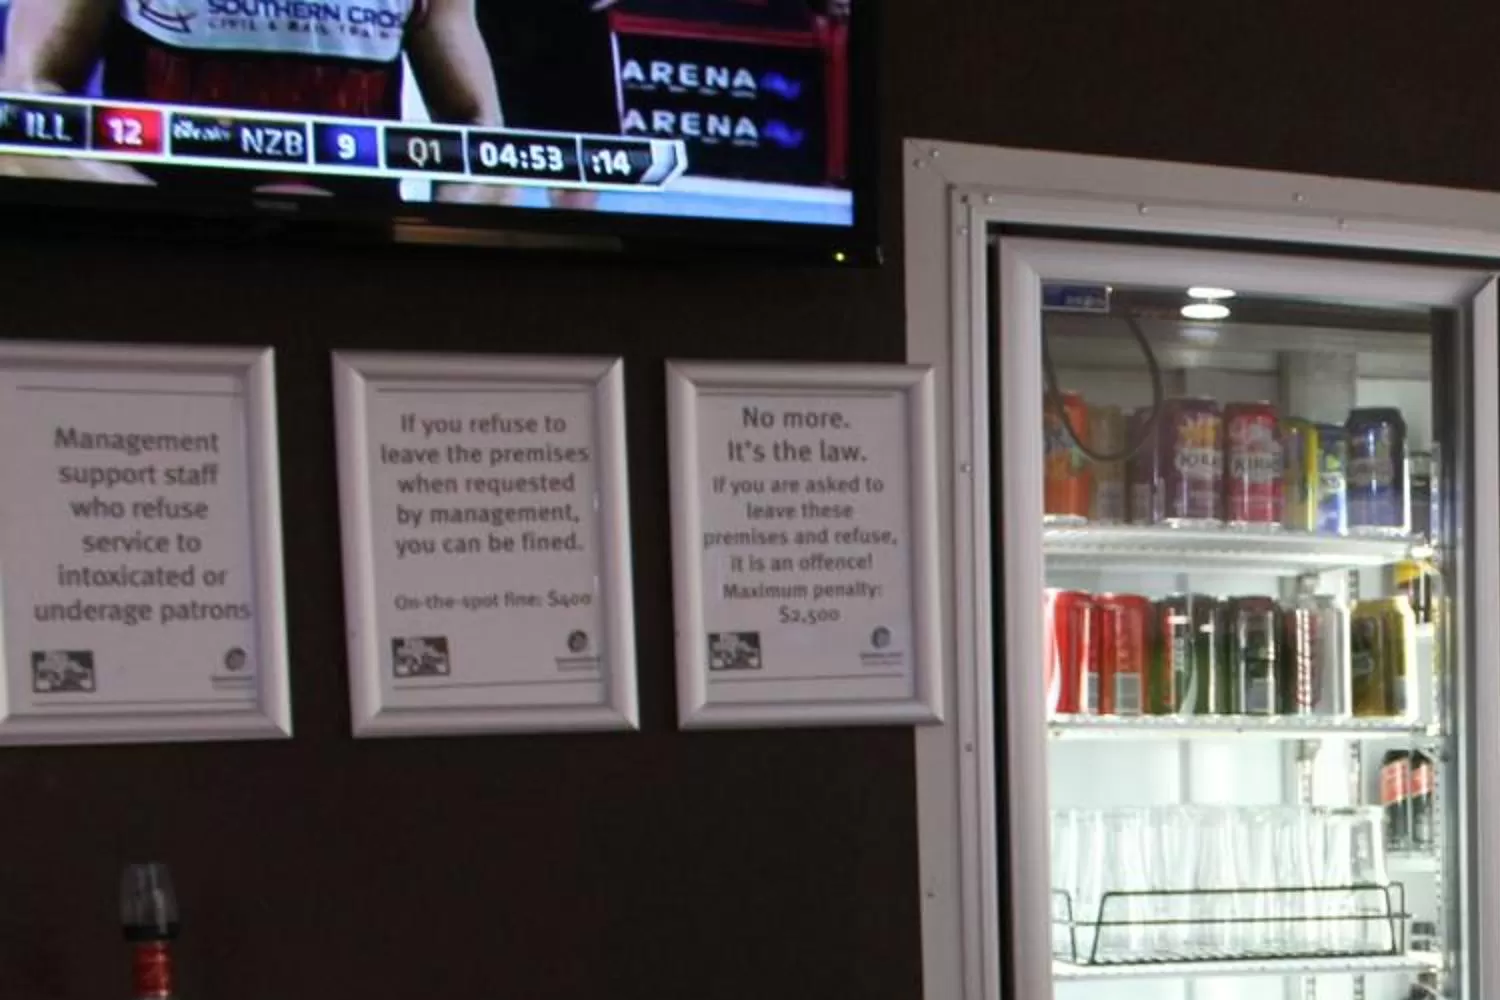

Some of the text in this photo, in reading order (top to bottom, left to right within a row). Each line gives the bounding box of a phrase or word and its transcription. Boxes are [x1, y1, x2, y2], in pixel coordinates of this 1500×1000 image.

[623, 59, 757, 91] ARENA
[623, 109, 759, 139] ARENA
[25, 110, 72, 141] ILL
[107, 116, 144, 146] 12
[240, 126, 304, 157] NZB
[336, 134, 356, 160] 9
[408, 137, 441, 166] Q1
[479, 143, 564, 172] 04:53
[592, 149, 631, 177] :14
[401, 413, 567, 436] If you refuse to
[742, 407, 850, 429] No more.
[54, 427, 219, 455] Management
[728, 440, 867, 462] It's the law.
[381, 444, 589, 466] leave the premises
[58, 464, 219, 488] support staff
[397, 473, 575, 496] when requested
[713, 476, 884, 496] If you are asked to
[69, 497, 208, 520] who refuse
[397, 503, 580, 527] by management,
[747, 501, 854, 519] leave these
[82, 531, 202, 553] service to
[395, 531, 583, 559] you can be fined.
[704, 529, 788, 549] premises
[794, 528, 828, 545] and
[750, 555, 765, 572] is
[771, 557, 793, 571] an
[799, 553, 873, 571] offence!
[58, 564, 227, 588] intoxicated or
[723, 581, 883, 602] Maximum penalty:
[35, 600, 251, 625] underage patrons
